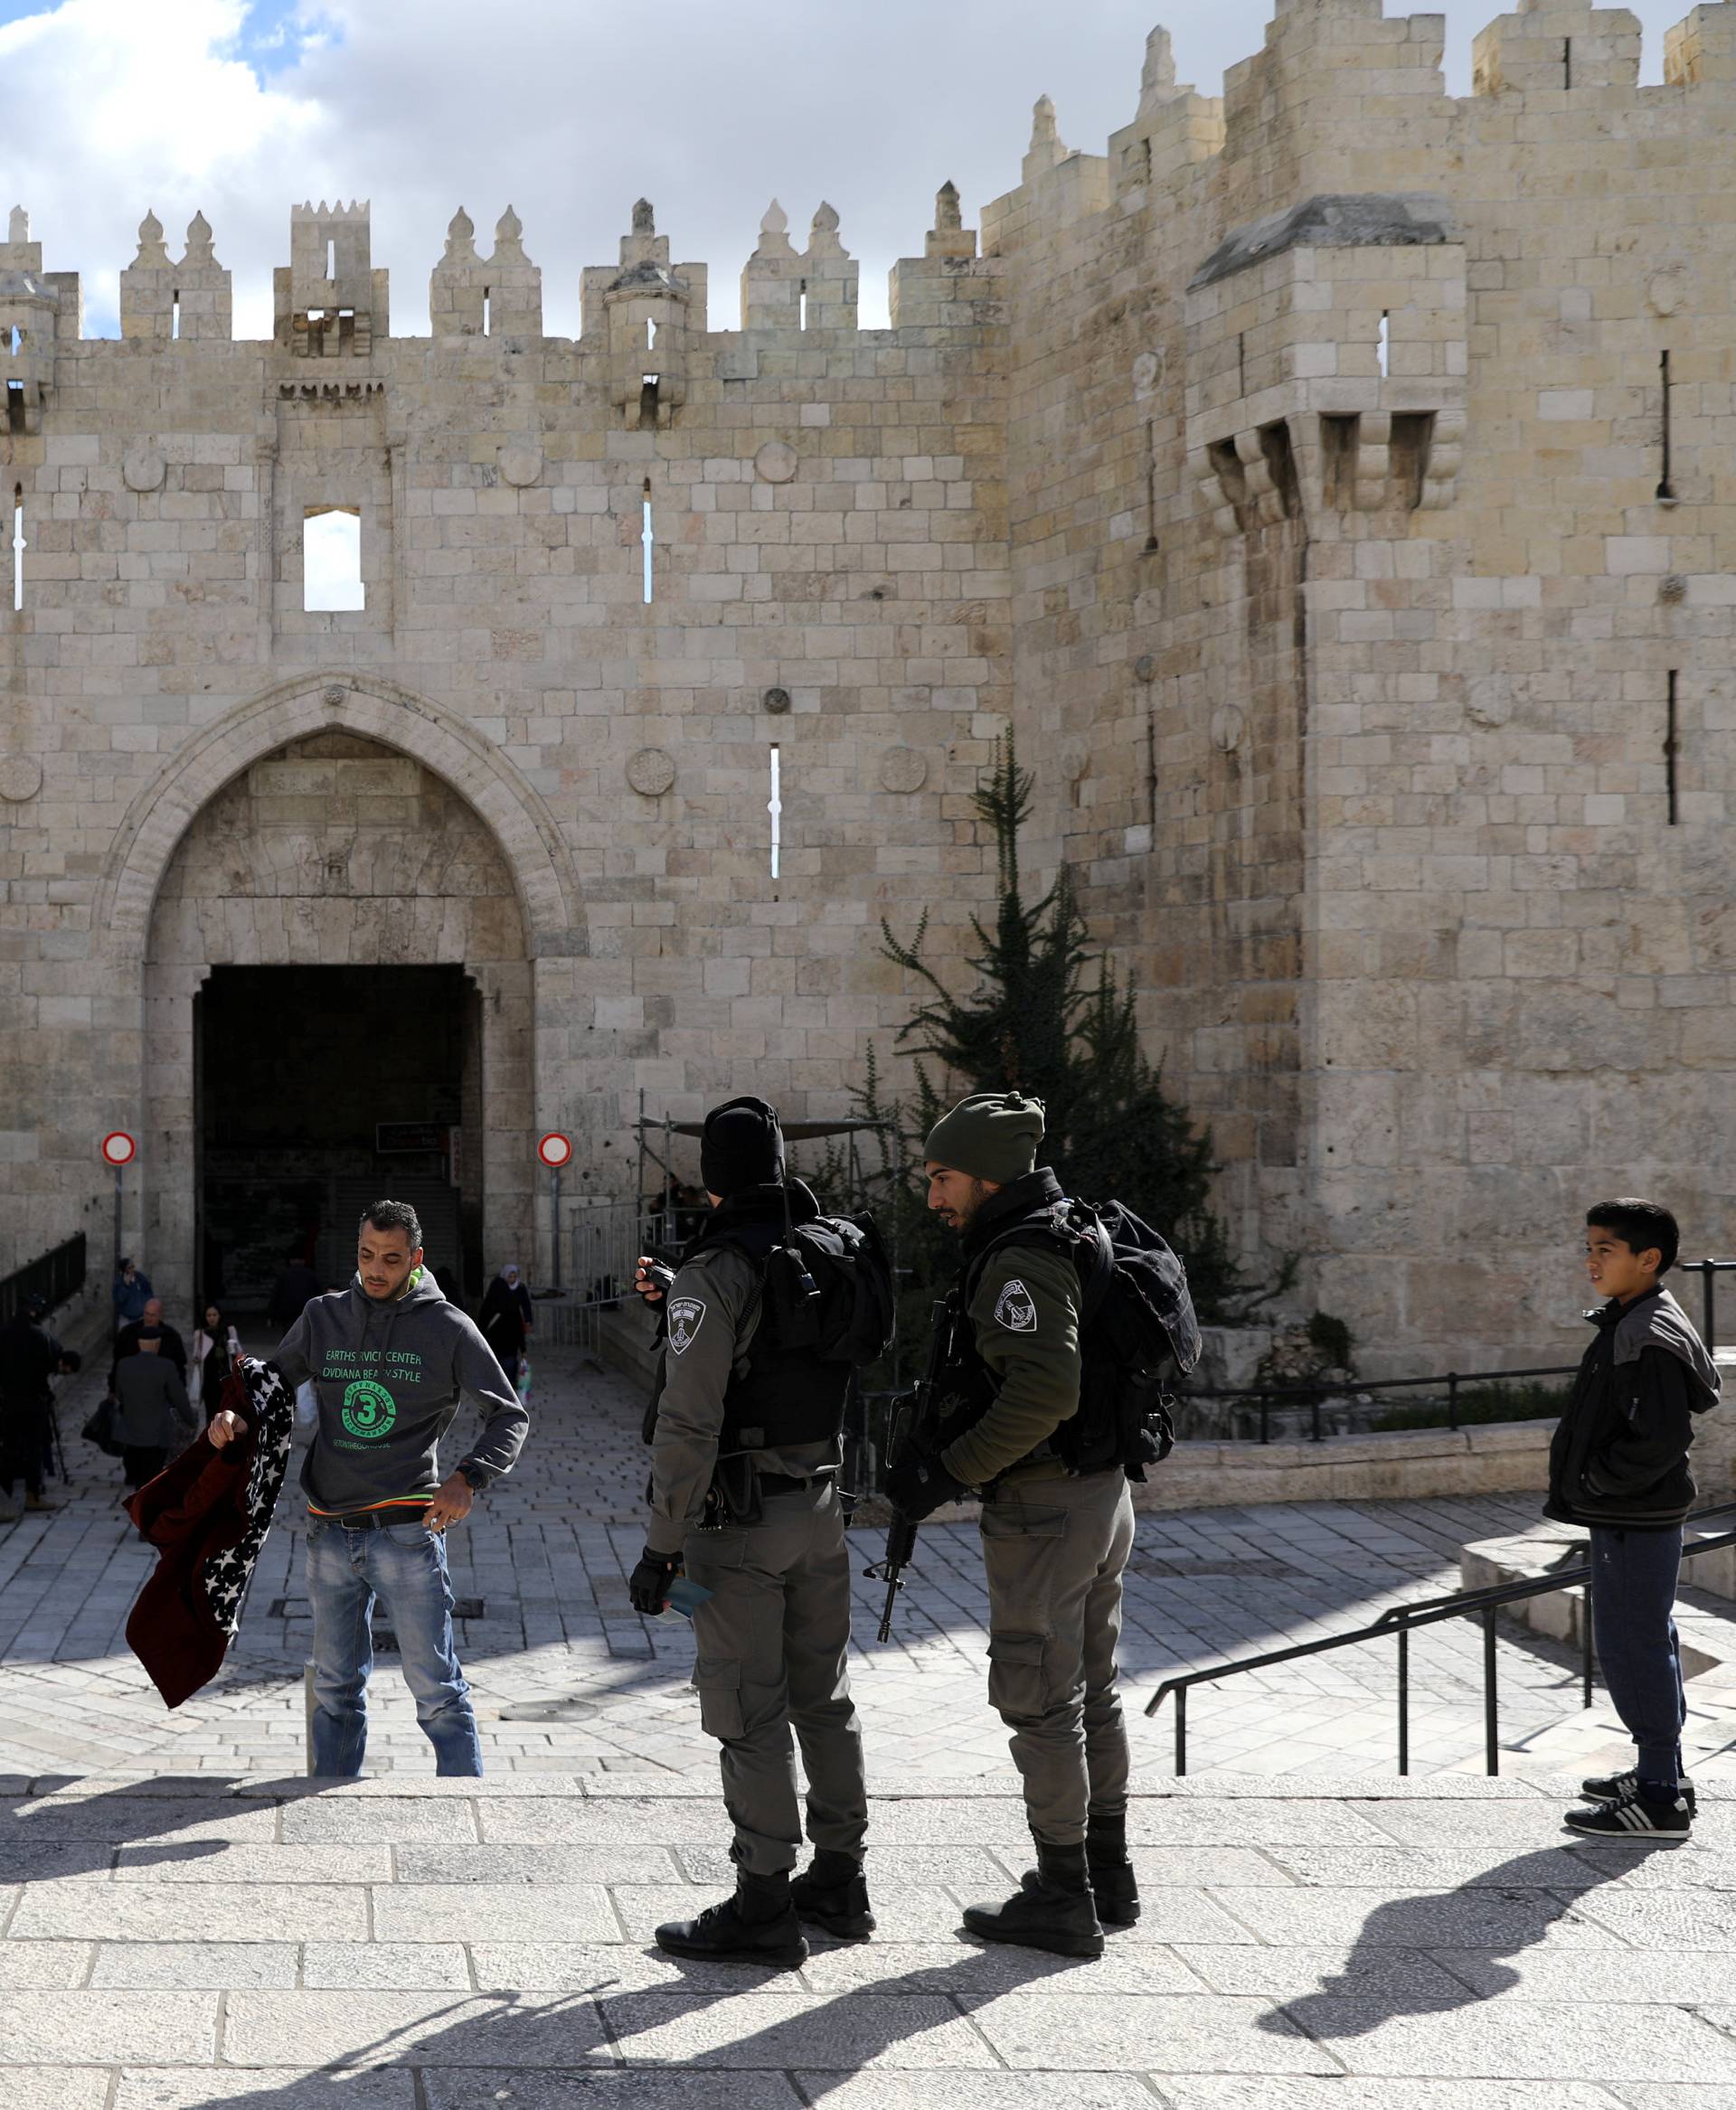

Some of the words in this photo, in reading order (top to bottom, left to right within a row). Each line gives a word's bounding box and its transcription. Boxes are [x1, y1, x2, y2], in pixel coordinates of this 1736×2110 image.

[385, 1352, 422, 1365] CENTER
[392, 1369, 421, 1383] STYLE
[356, 1395, 376, 1425] 3
